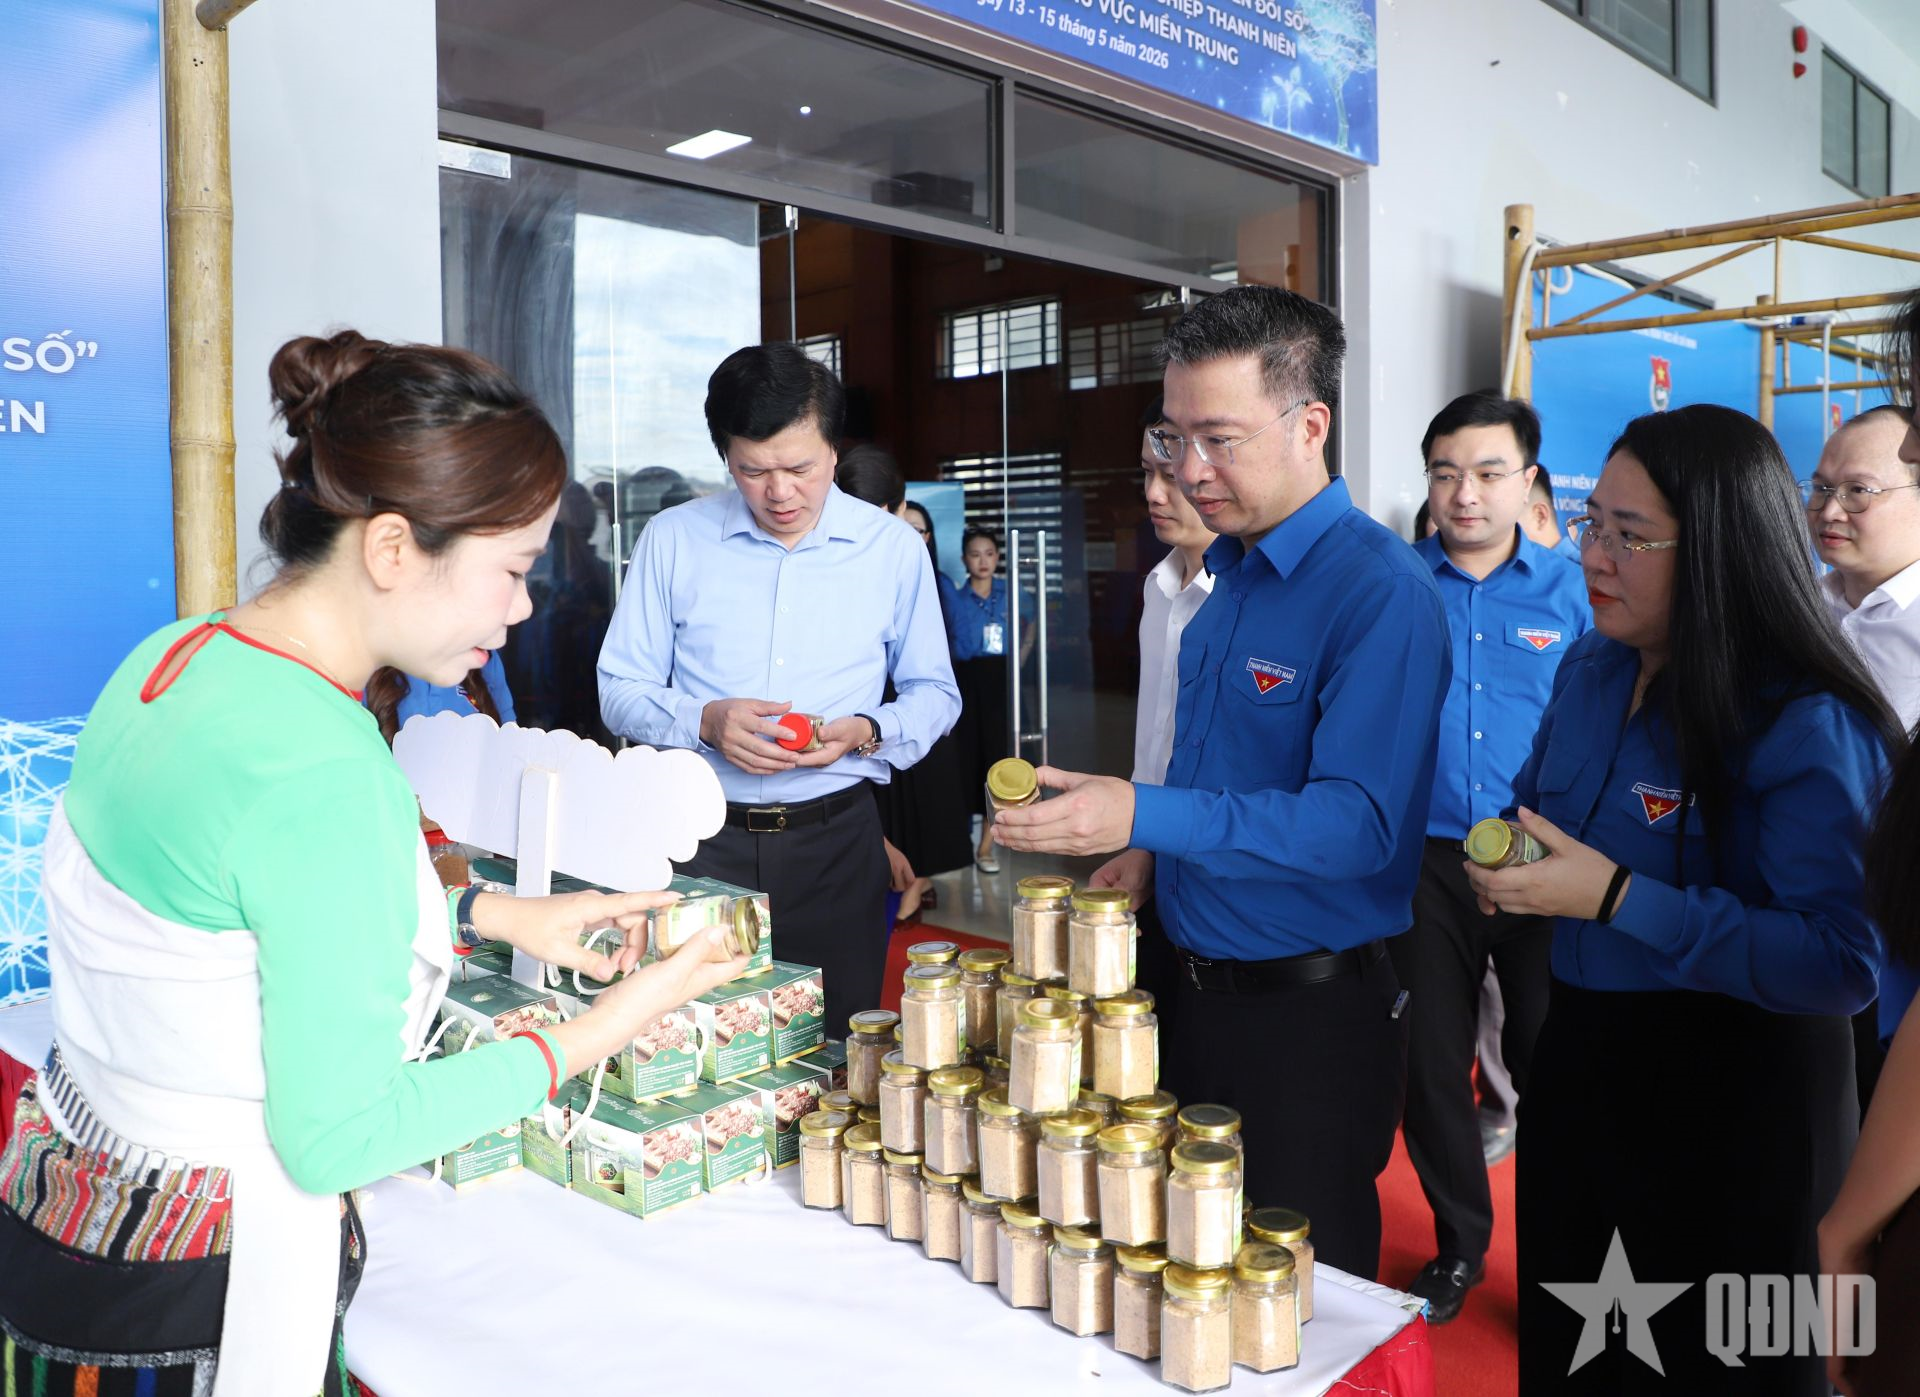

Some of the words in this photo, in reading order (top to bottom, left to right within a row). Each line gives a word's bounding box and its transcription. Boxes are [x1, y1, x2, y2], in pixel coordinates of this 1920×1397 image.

[1009, 0, 1026, 16] 13
[1039, 6, 1056, 27] 15
[1058, 13, 1096, 47] tháng
[1098, 28, 1107, 46] 5
[1109, 35, 1137, 58] năm
[1138, 43, 1169, 70] 2026
[1099, 0, 1136, 25] VỰC
[1139, 9, 1182, 44] MIỀN
[1185, 28, 1239, 66] TRUNG
[1206, 5, 1259, 43] THANH
[1263, 30, 1297, 59] NIÊN
[2, 329, 98, 374] SỐ”
[0, 399, 46, 434] N
